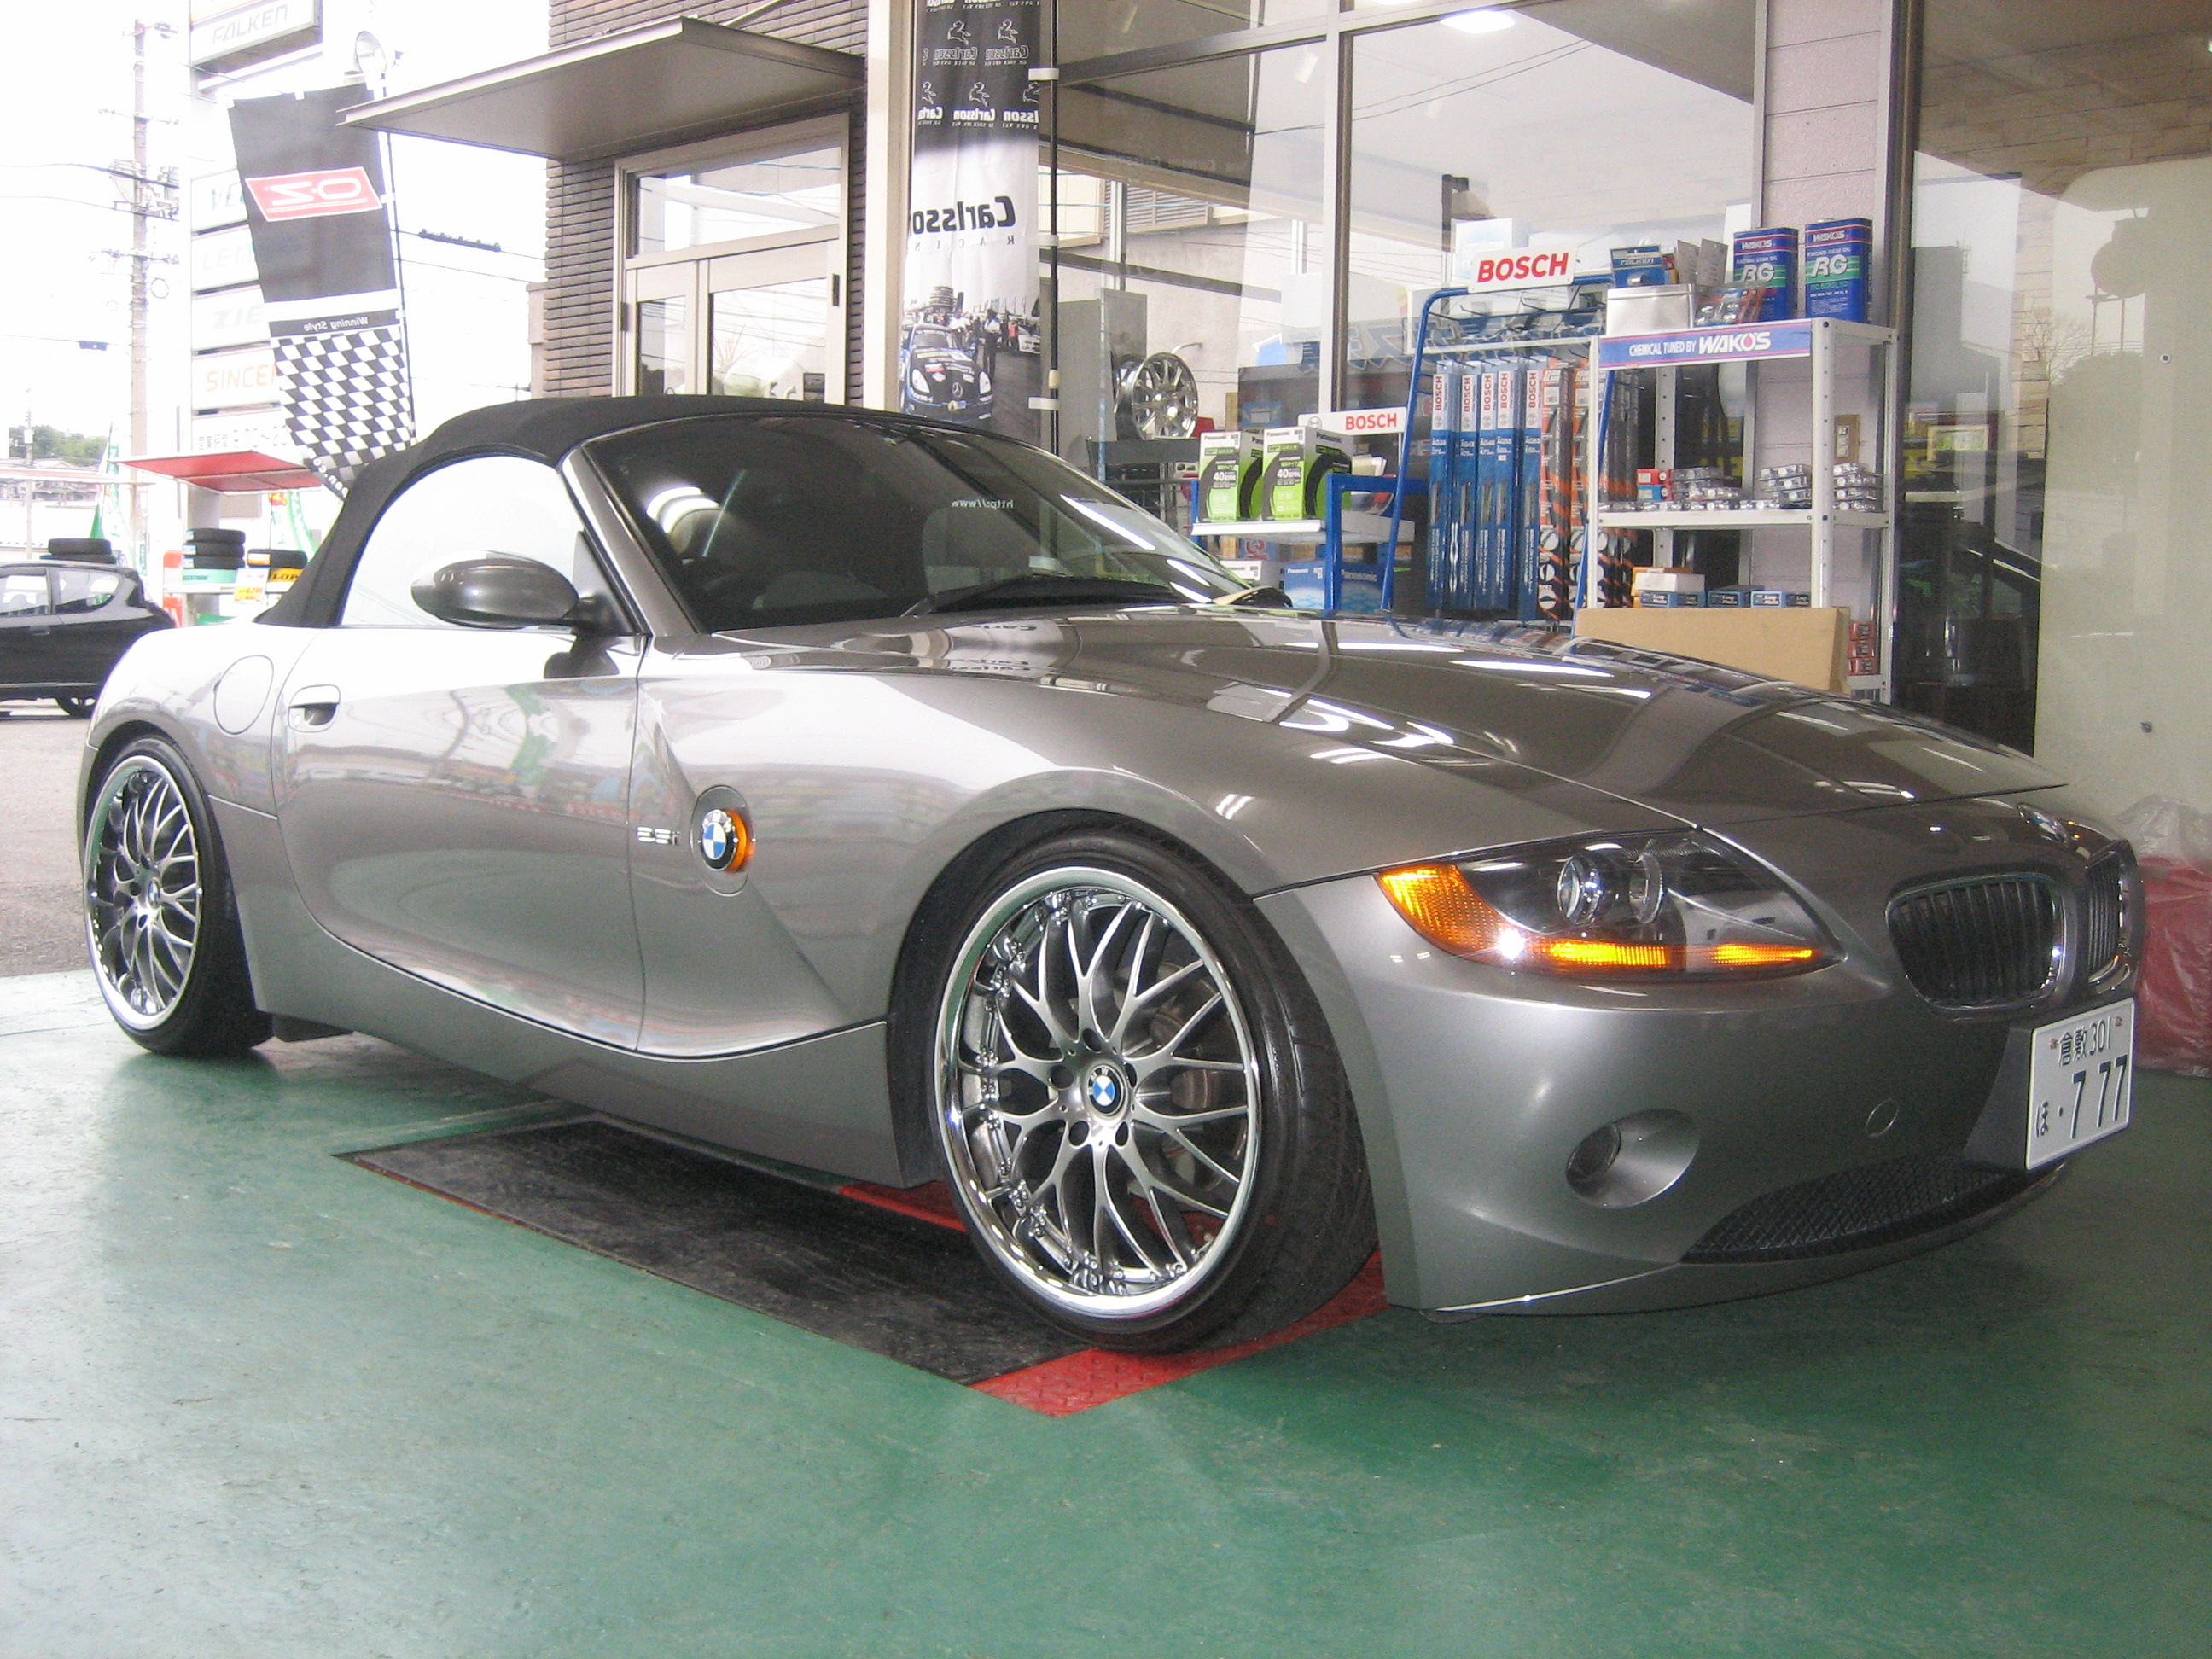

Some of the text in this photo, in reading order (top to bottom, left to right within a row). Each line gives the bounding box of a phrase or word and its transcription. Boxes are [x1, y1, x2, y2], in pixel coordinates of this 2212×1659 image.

[212, 3, 288, 44] FALKEN
[1476, 252, 1569, 283] BOSCH
[1811, 254, 1848, 278] RG
[1628, 341, 1662, 357] CHEMICAL
[1663, 341, 1685, 354] TUNED
[1686, 340, 1697, 352] BY
[1435, 375, 1443, 410] BOSCH
[1463, 377, 1471, 412] BOSCH
[1483, 375, 1492, 410] BOSCH
[1499, 372, 1508, 409] BOSCH
[1528, 371, 1537, 409] BOSCH
[1345, 413, 1397, 430] BOSCH
